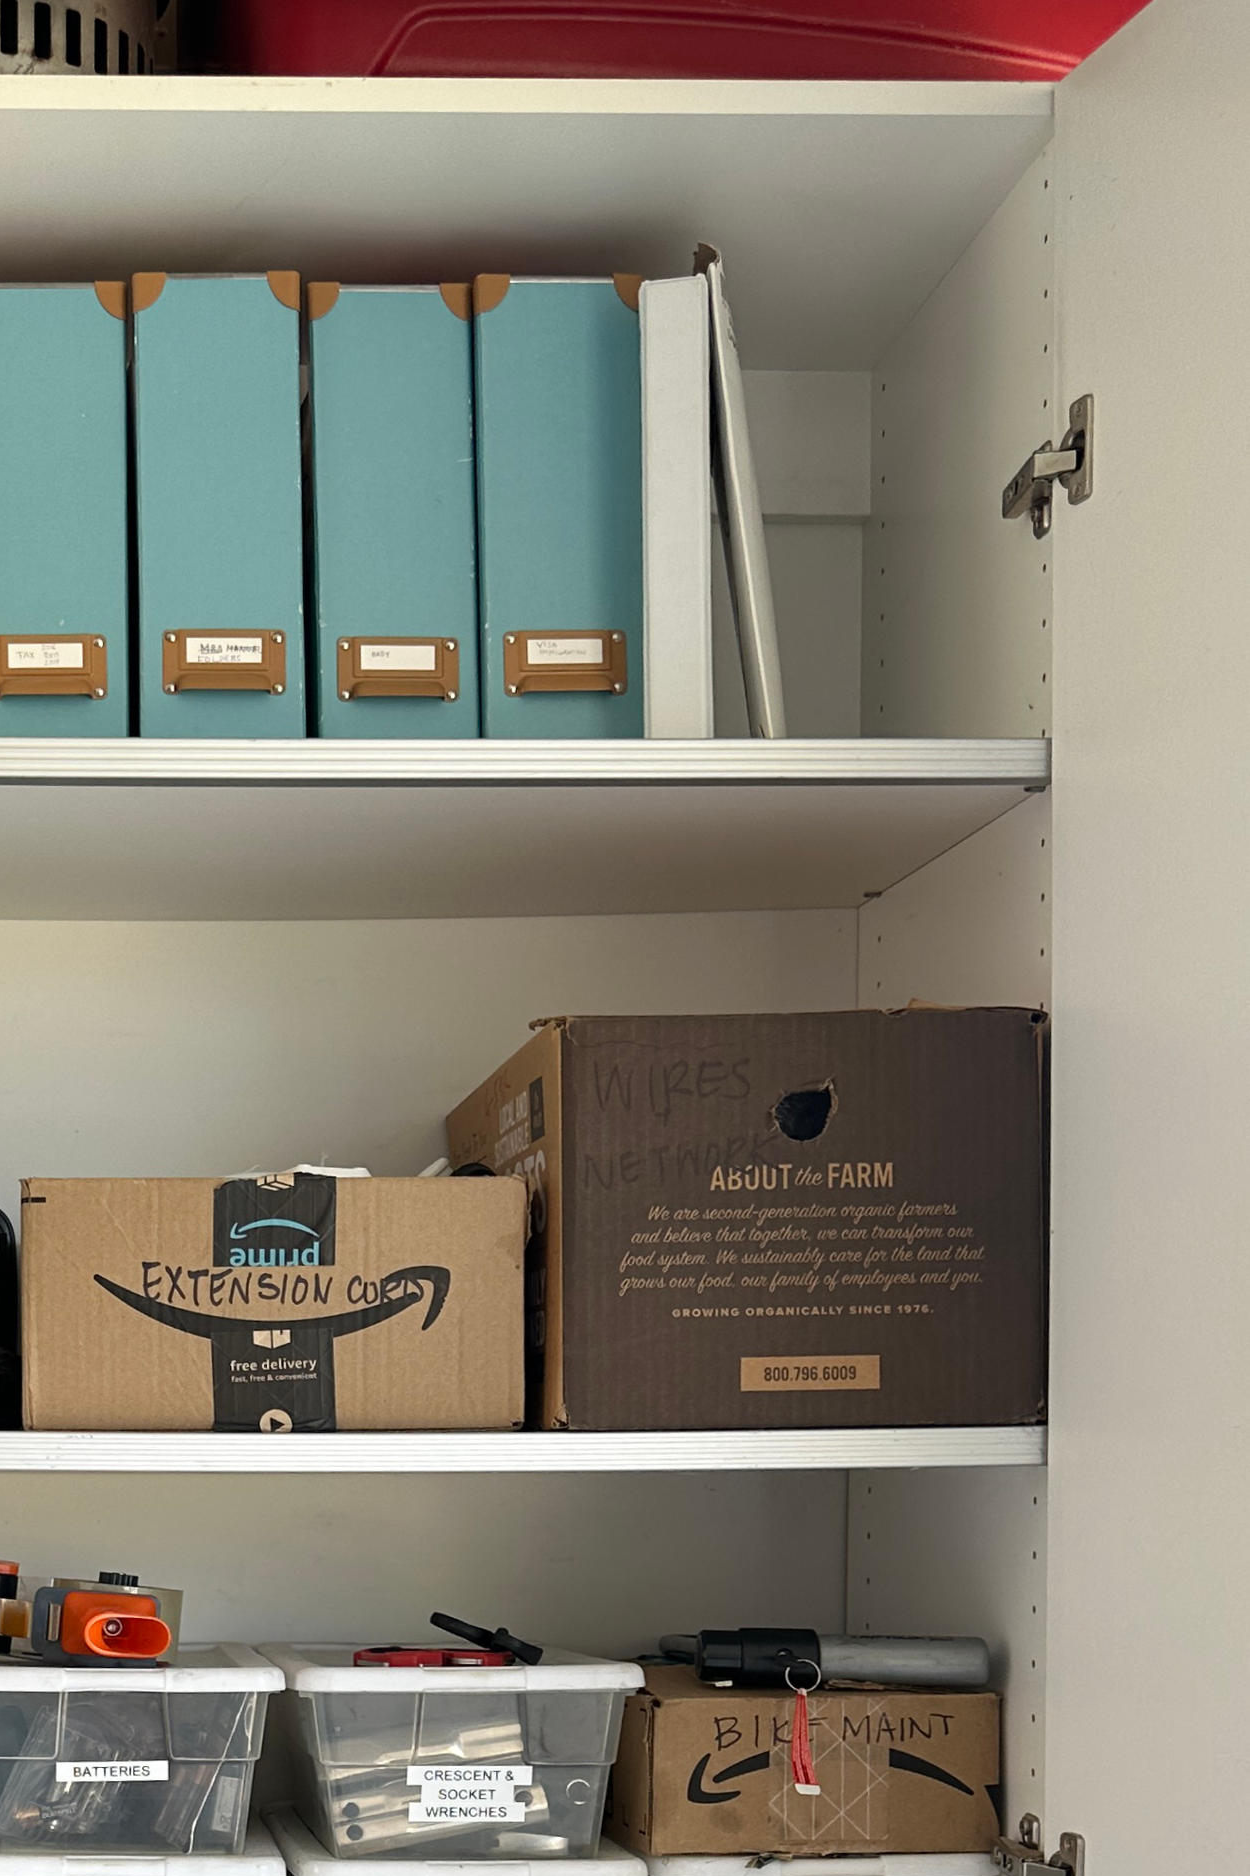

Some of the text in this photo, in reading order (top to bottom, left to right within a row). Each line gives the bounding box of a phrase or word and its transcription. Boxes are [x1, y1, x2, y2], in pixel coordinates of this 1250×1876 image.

[16, 651, 35, 659] TAX
[593, 1058, 752, 1127] WIRES
[584, 1132, 781, 1191] NETWORK
[710, 1162, 894, 1191] ABOUT the FARM
[648, 1201, 958, 1227] We are second-generation organic farmers
[631, 1228, 662, 1244] and
[663, 1227, 713, 1243] believe
[715, 1225, 746, 1242] that
[817, 1228, 838, 1240] we
[841, 1228, 868, 1240] can
[871, 1223, 944, 1245] transform
[947, 1226, 975, 1238] our
[619, 1251, 656, 1273] food
[715, 1249, 738, 1265] We
[741, 1247, 825, 1271] sustainably
[829, 1251, 863, 1263] care
[863, 1246, 888, 1269] for
[891, 1246, 914, 1262] the
[916, 1245, 952, 1262] land
[954, 1244, 985, 1261] that
[141, 1261, 333, 1307] EXTENSION
[619, 1276, 667, 1297] grows
[669, 1277, 697, 1289] our
[741, 1275, 768, 1288] our
[768, 1270, 820, 1294] family
[823, 1270, 840, 1292] of
[841, 1268, 917, 1292] employees
[920, 1268, 951, 1285] and
[950, 1272, 983, 1291] you.
[672, 1304, 934, 1318] GROWING ORGANICALLY SINCE 1976.
[230, 1357, 318, 1372] free delivery
[763, 1364, 857, 1383] 800.796.6009
[842, 1712, 955, 1743] MAINT
[73, 1764, 151, 1778] BATTERIES
[424, 1769, 515, 1782] CRESCENT &
[438, 1788, 496, 1801] SOCKET
[425, 1806, 508, 1819] WRENCHES
